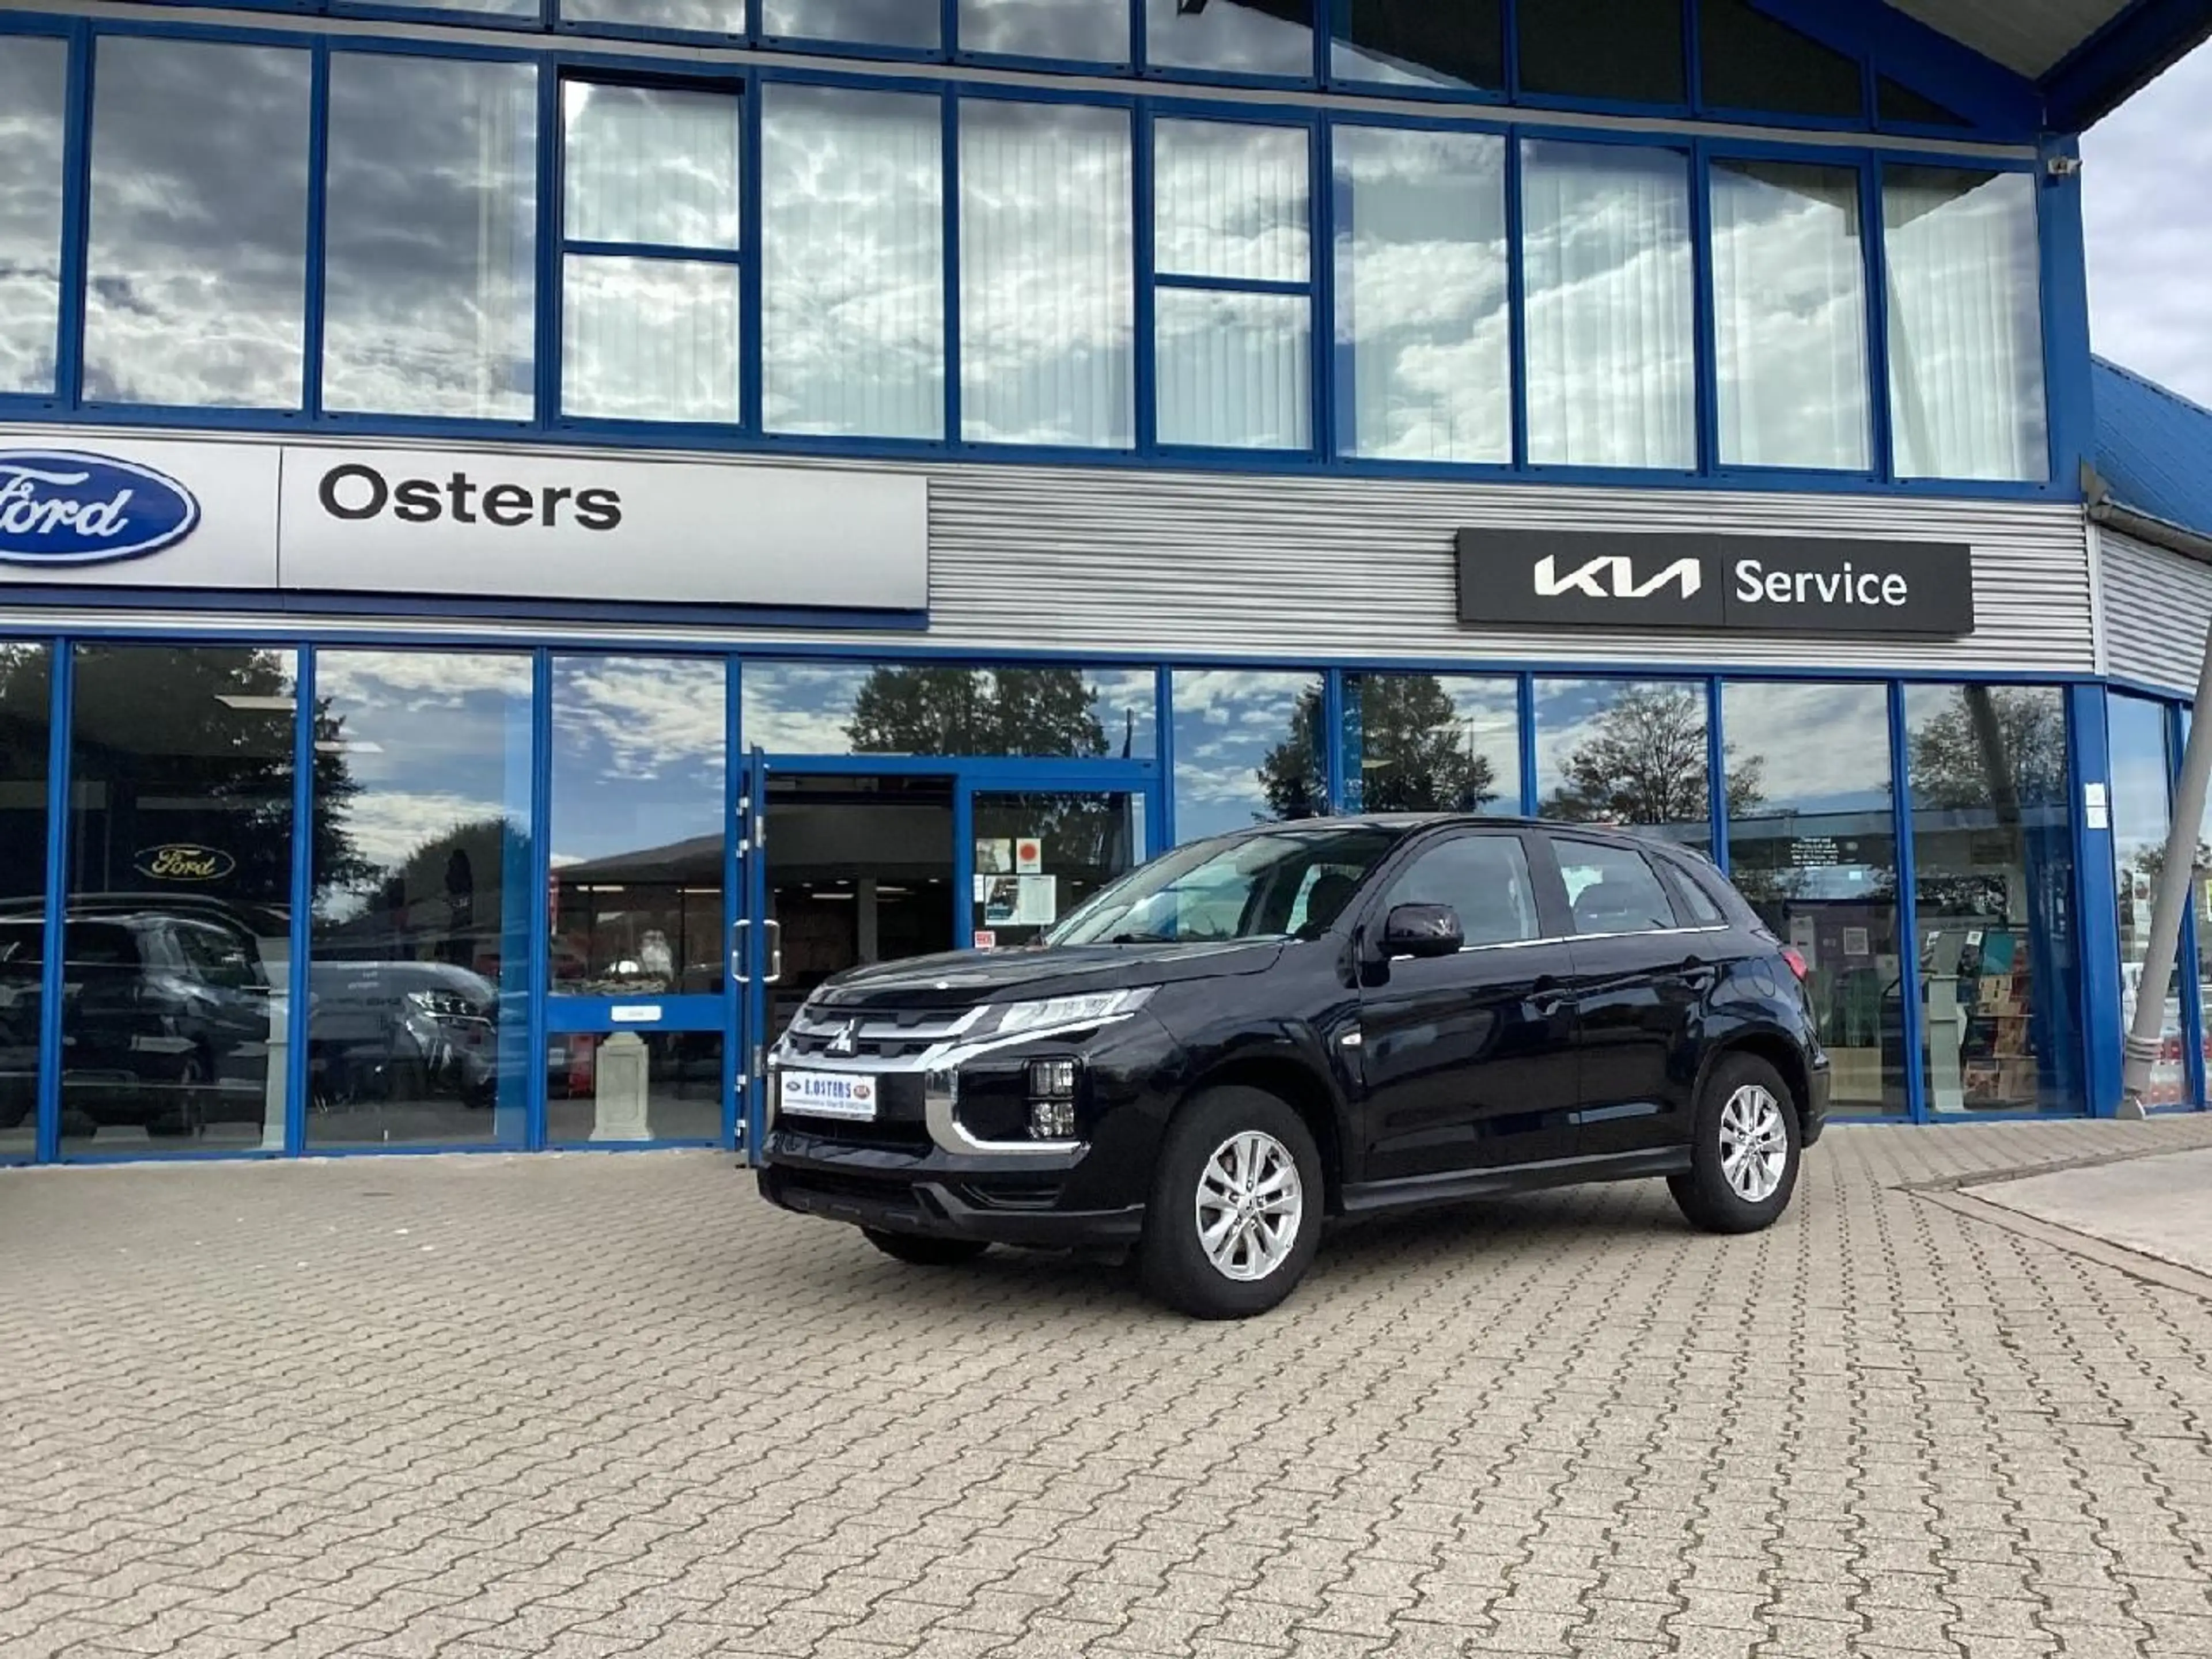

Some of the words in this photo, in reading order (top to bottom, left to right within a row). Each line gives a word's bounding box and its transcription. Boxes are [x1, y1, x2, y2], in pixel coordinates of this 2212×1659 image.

[319, 464, 623, 530] Osters
[1534, 554, 1702, 599] KIA
[1735, 559, 1908, 605] Service
[152, 850, 215, 874] Ford
